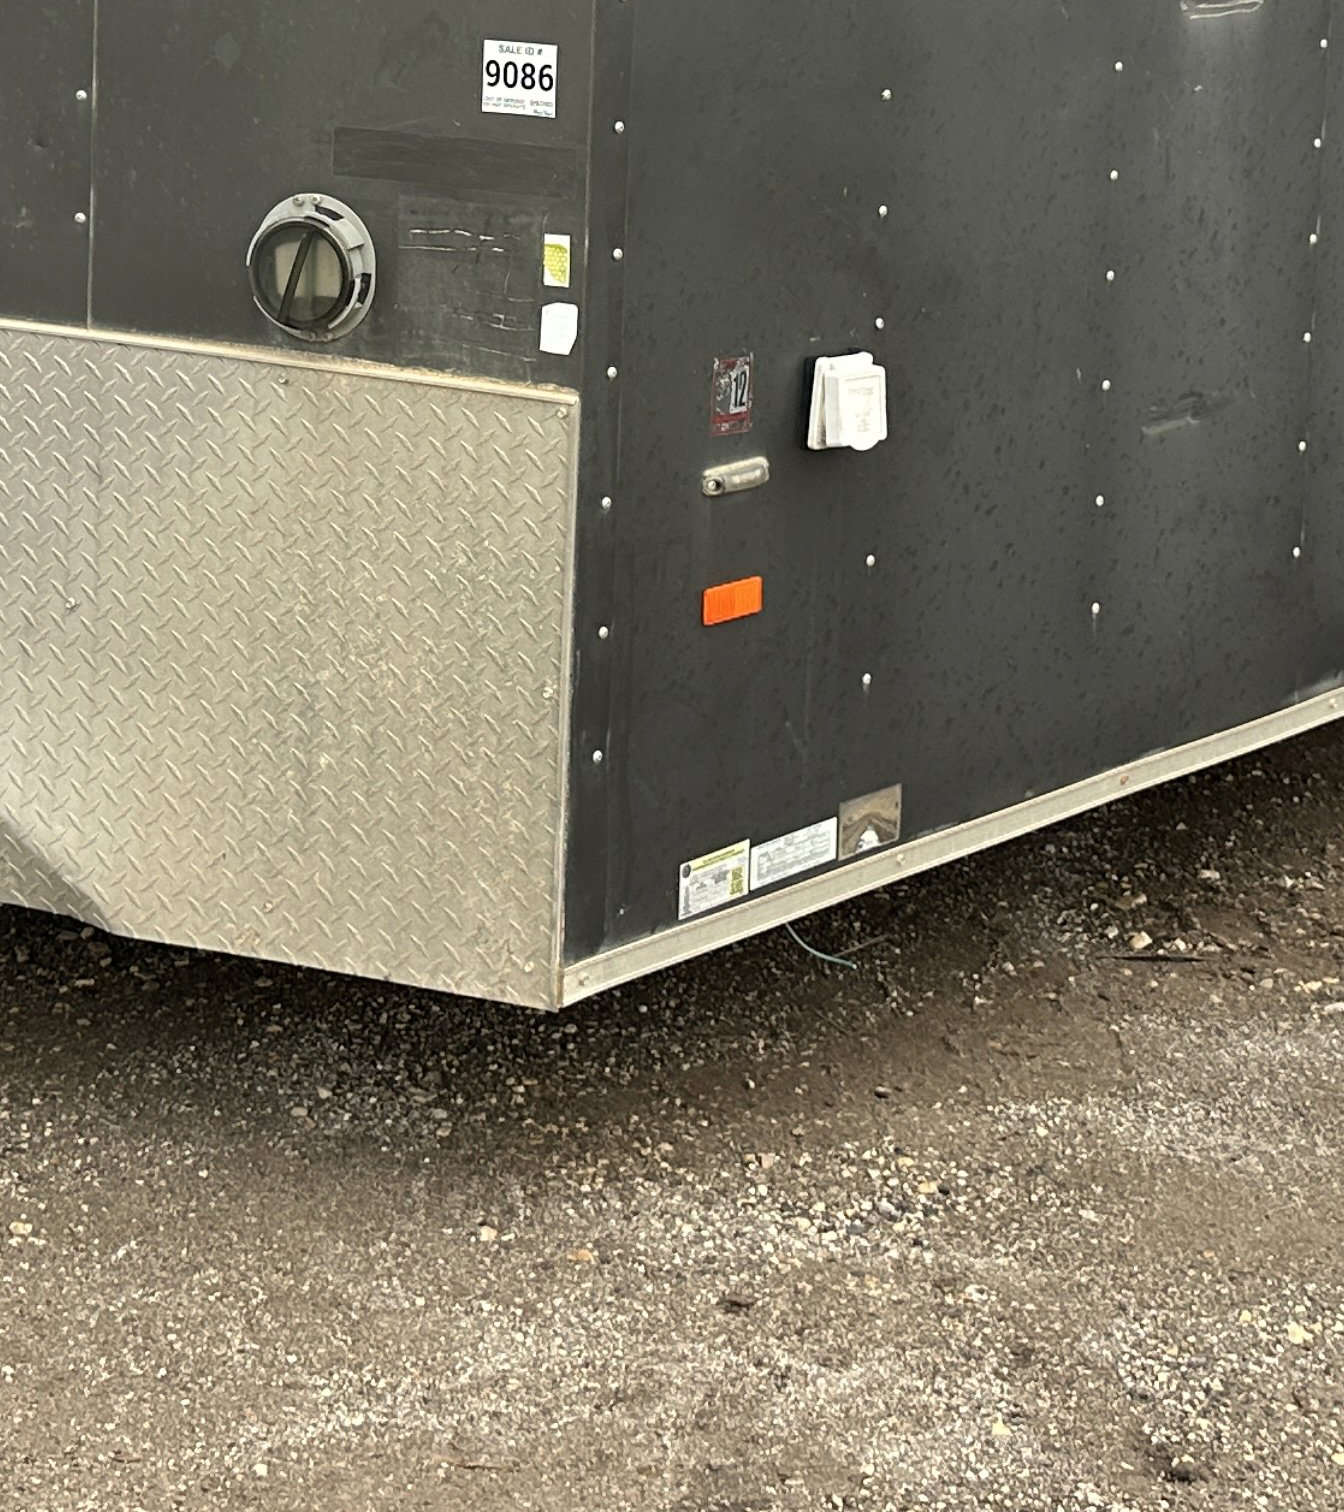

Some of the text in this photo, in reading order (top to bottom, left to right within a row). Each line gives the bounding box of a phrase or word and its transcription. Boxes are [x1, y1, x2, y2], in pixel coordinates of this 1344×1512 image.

[498, 44, 522, 54] SALE
[525, 47, 534, 56] ID
[485, 59, 554, 91] 9086
[733, 370, 747, 408] 12
